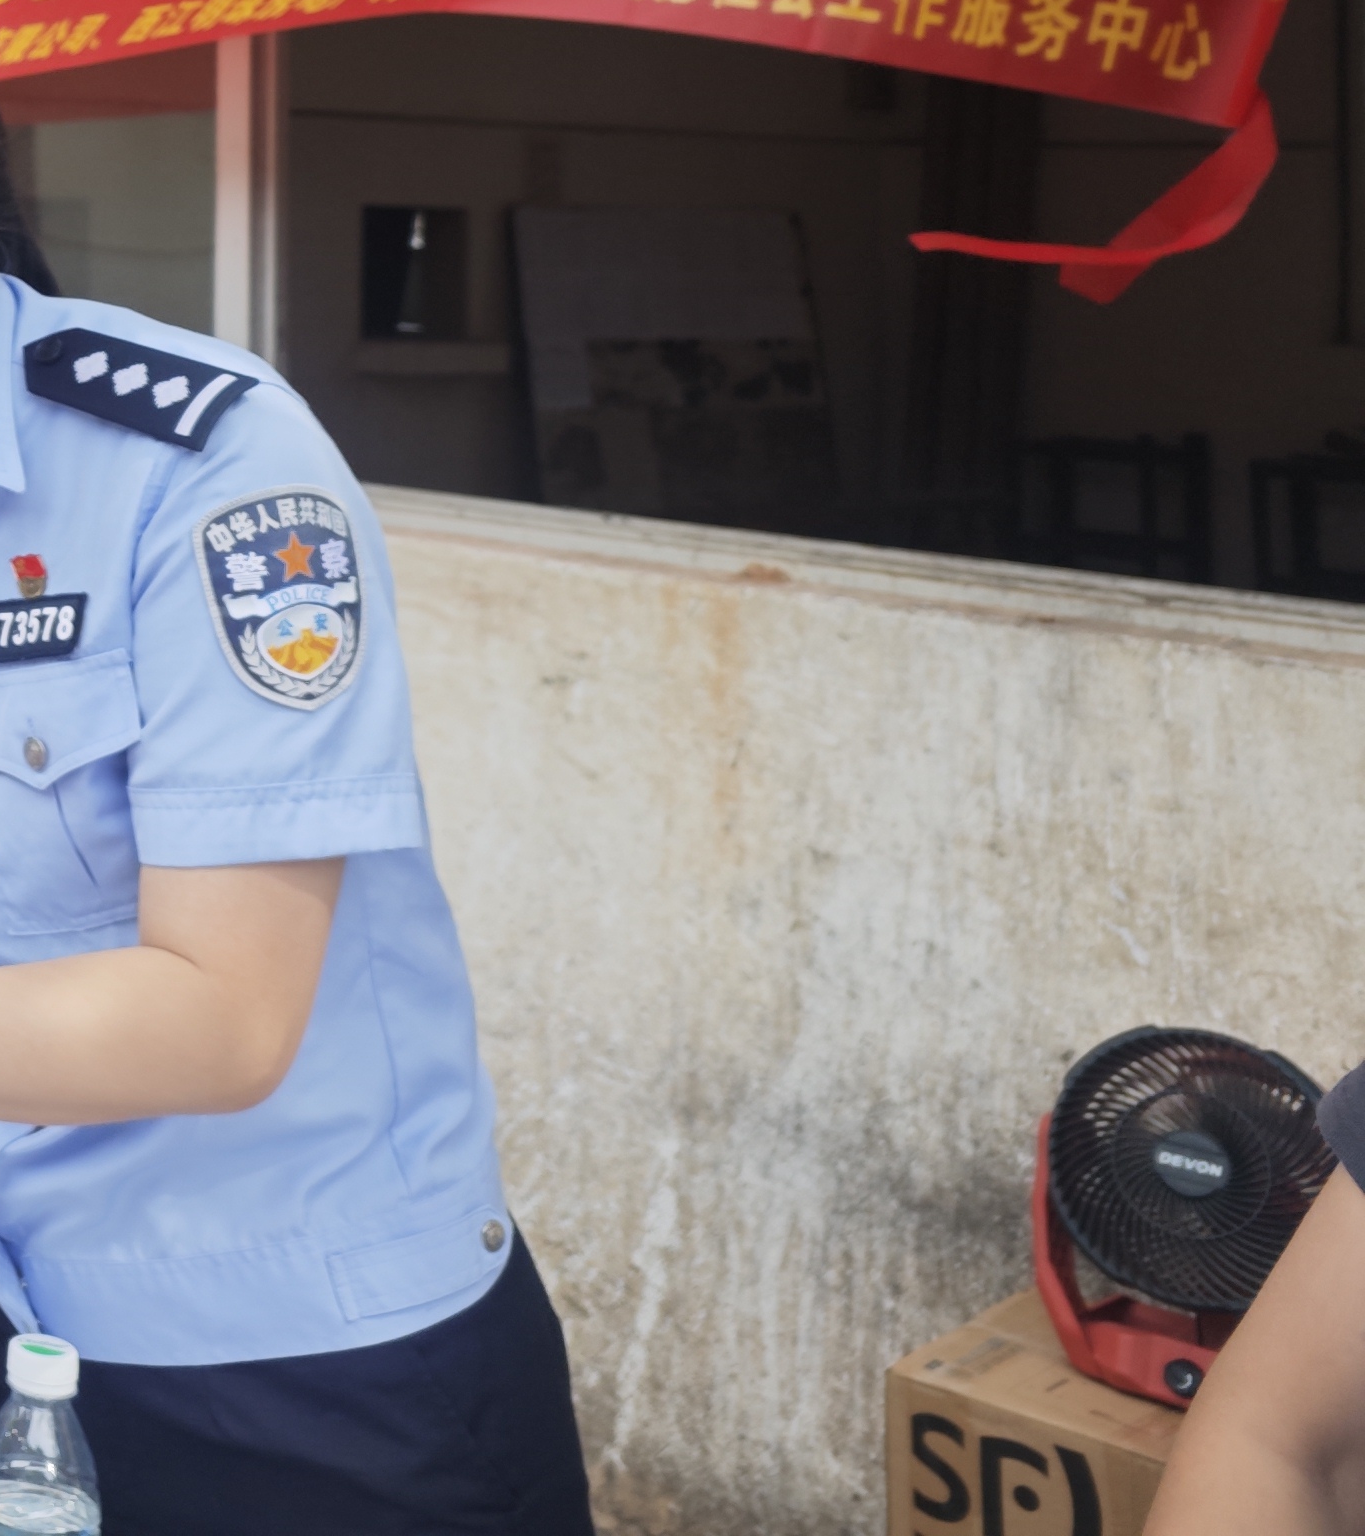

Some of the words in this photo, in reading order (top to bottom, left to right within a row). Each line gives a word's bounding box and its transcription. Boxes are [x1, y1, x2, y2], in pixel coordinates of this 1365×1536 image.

[206, 497, 348, 552] 中华人民共和国
[267, 584, 329, 614] POLICE
[1158, 1150, 1224, 1178] DEVON
